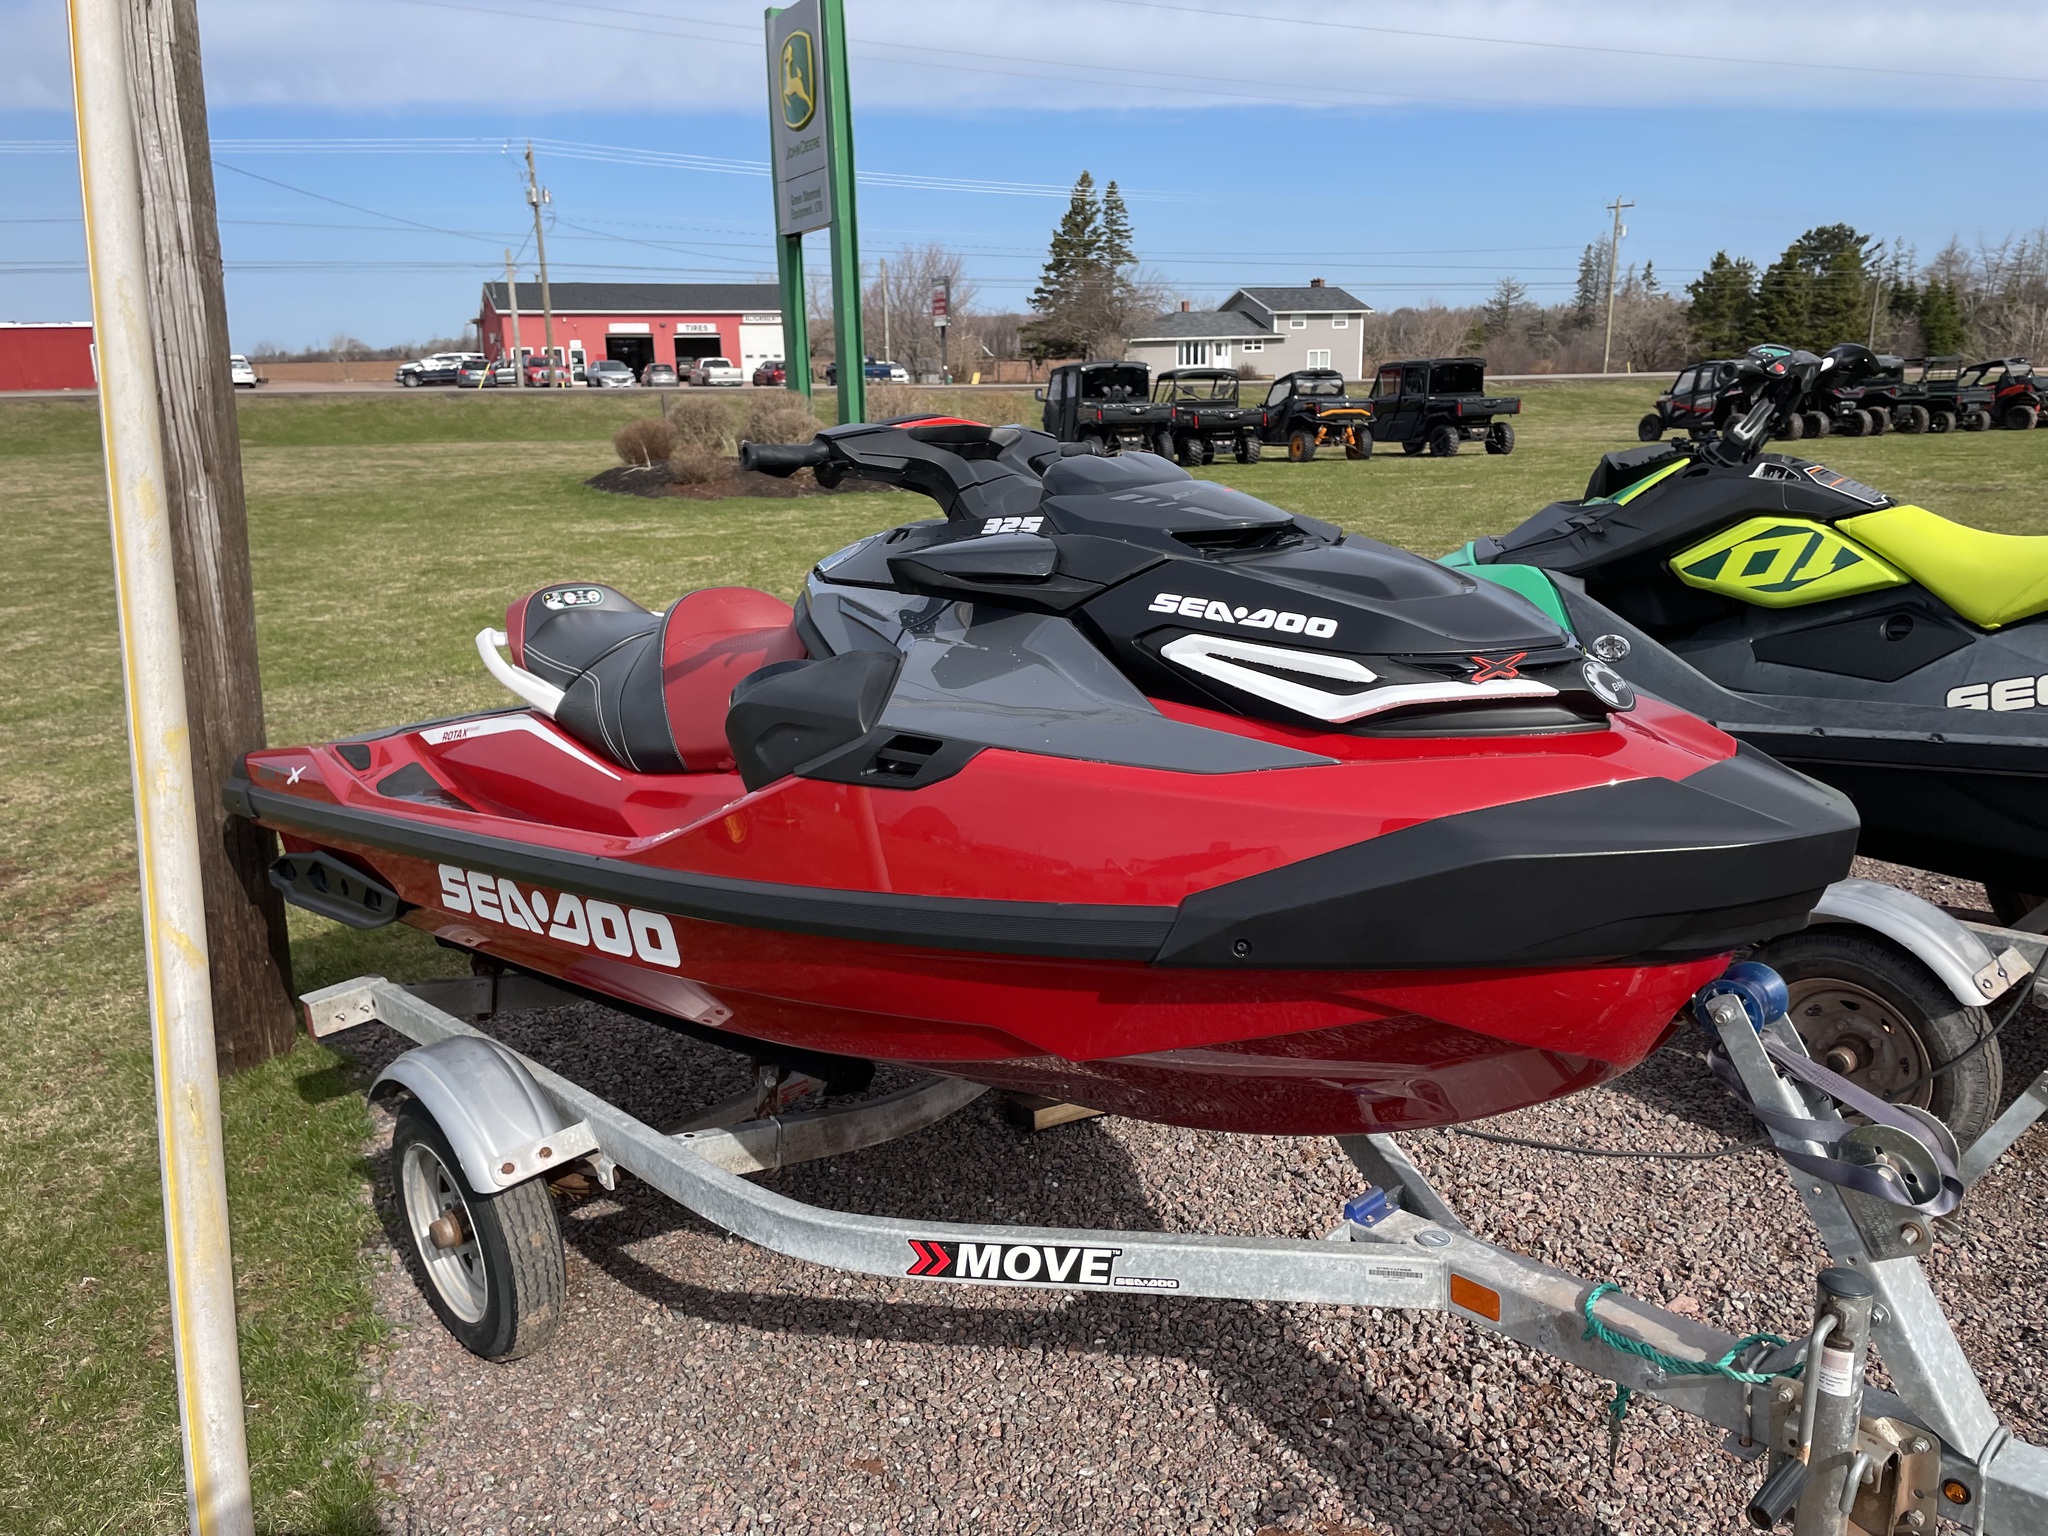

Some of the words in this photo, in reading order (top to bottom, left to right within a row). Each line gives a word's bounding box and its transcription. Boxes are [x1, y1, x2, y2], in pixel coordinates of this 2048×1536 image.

[685, 324, 709, 332] TIRES
[981, 516, 1044, 534] 325
[1946, 674, 2048, 711] SE
[442, 728, 469, 741] ROTAX
[955, 1243, 1113, 1284] MOVE
